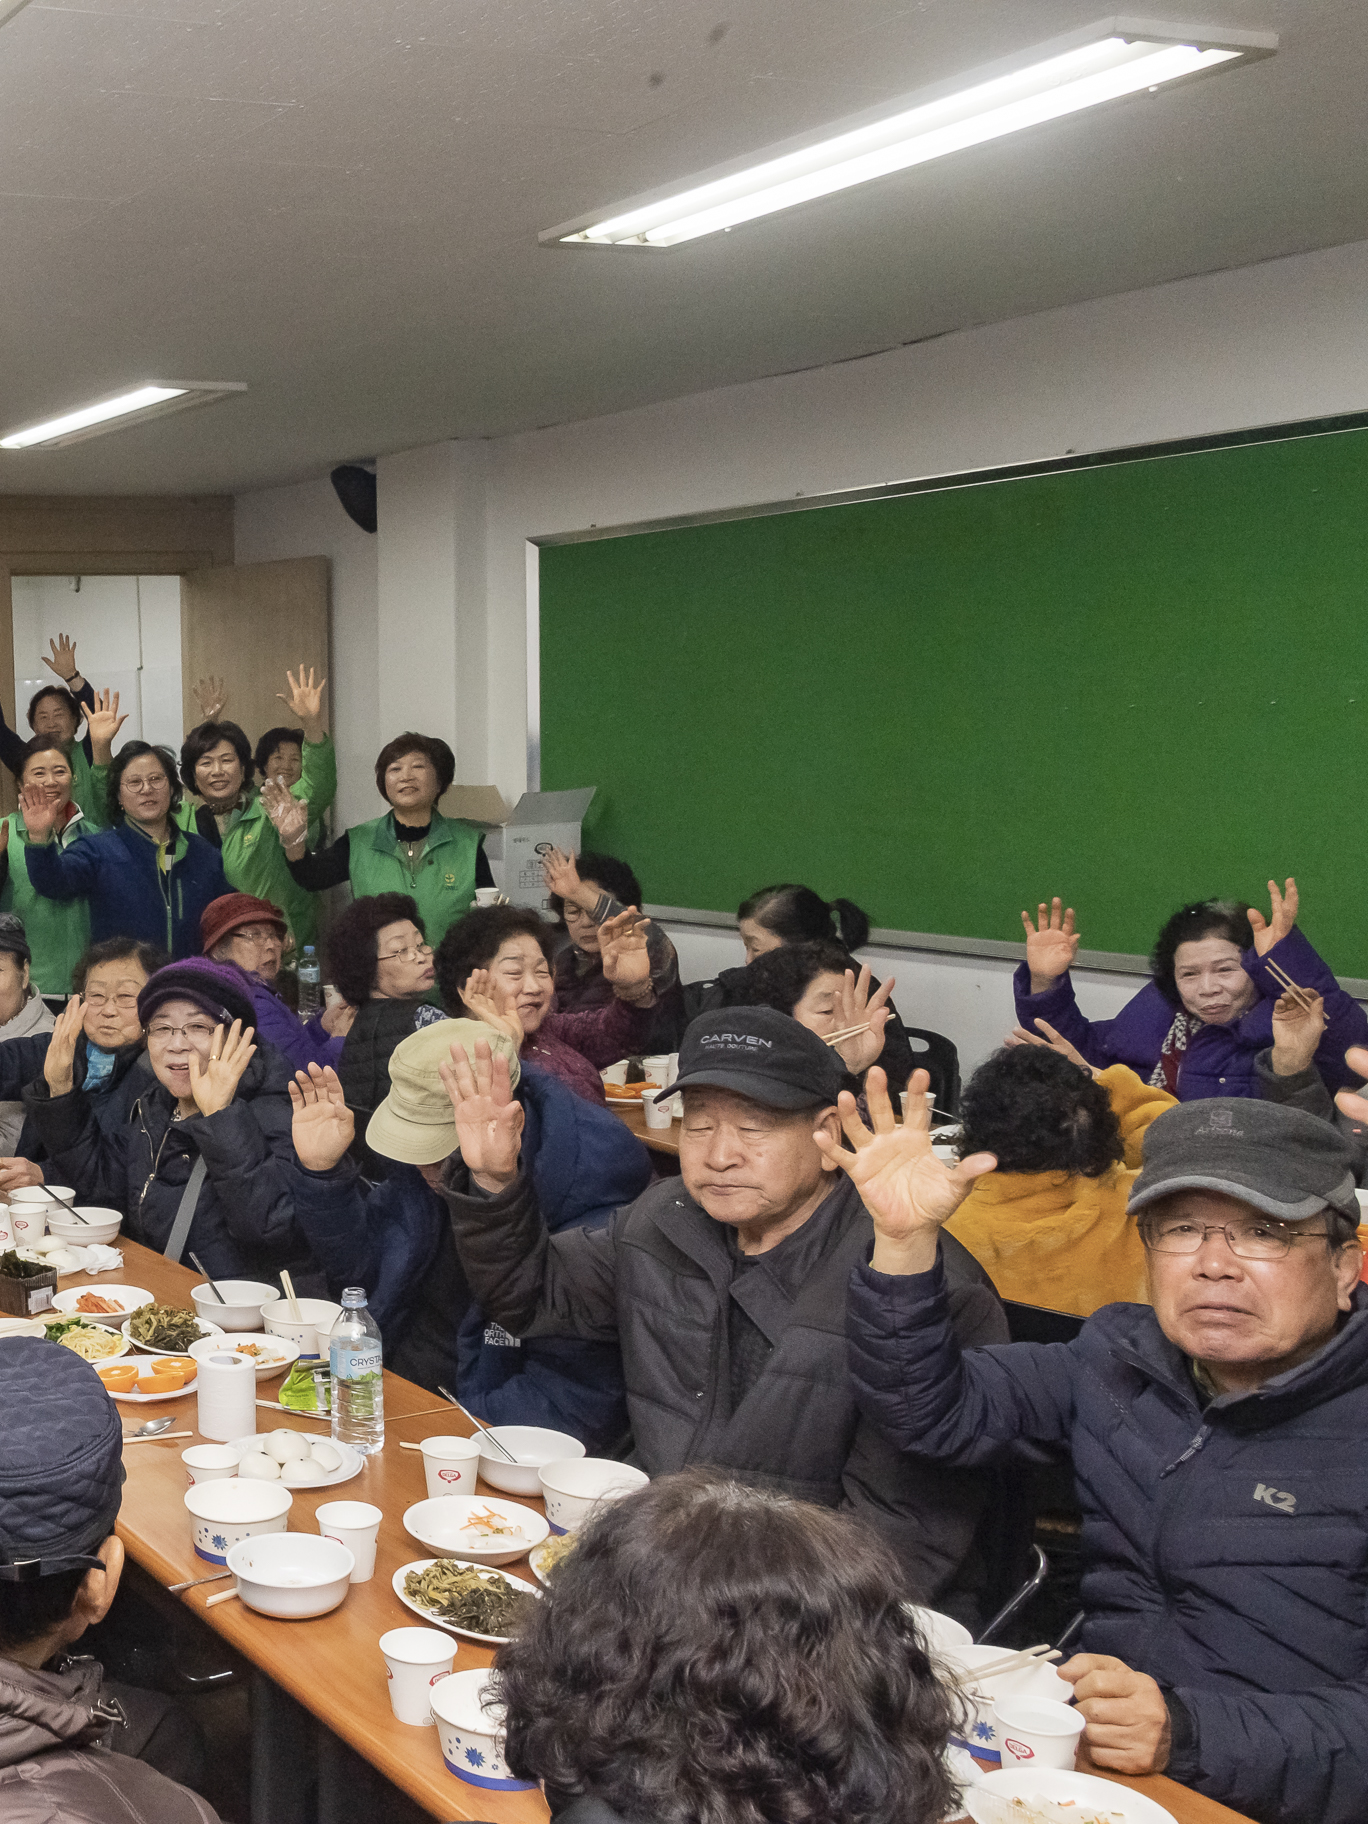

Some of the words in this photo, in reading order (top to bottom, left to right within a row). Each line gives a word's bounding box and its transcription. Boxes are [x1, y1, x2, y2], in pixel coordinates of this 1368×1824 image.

[700, 1033, 772, 1048] CARVEN
[484, 1328, 506, 1338] ORTH
[484, 1336, 506, 1346] FACE
[349, 1354, 383, 1367] CRYSTA
[1253, 1482, 1297, 1513] K2
